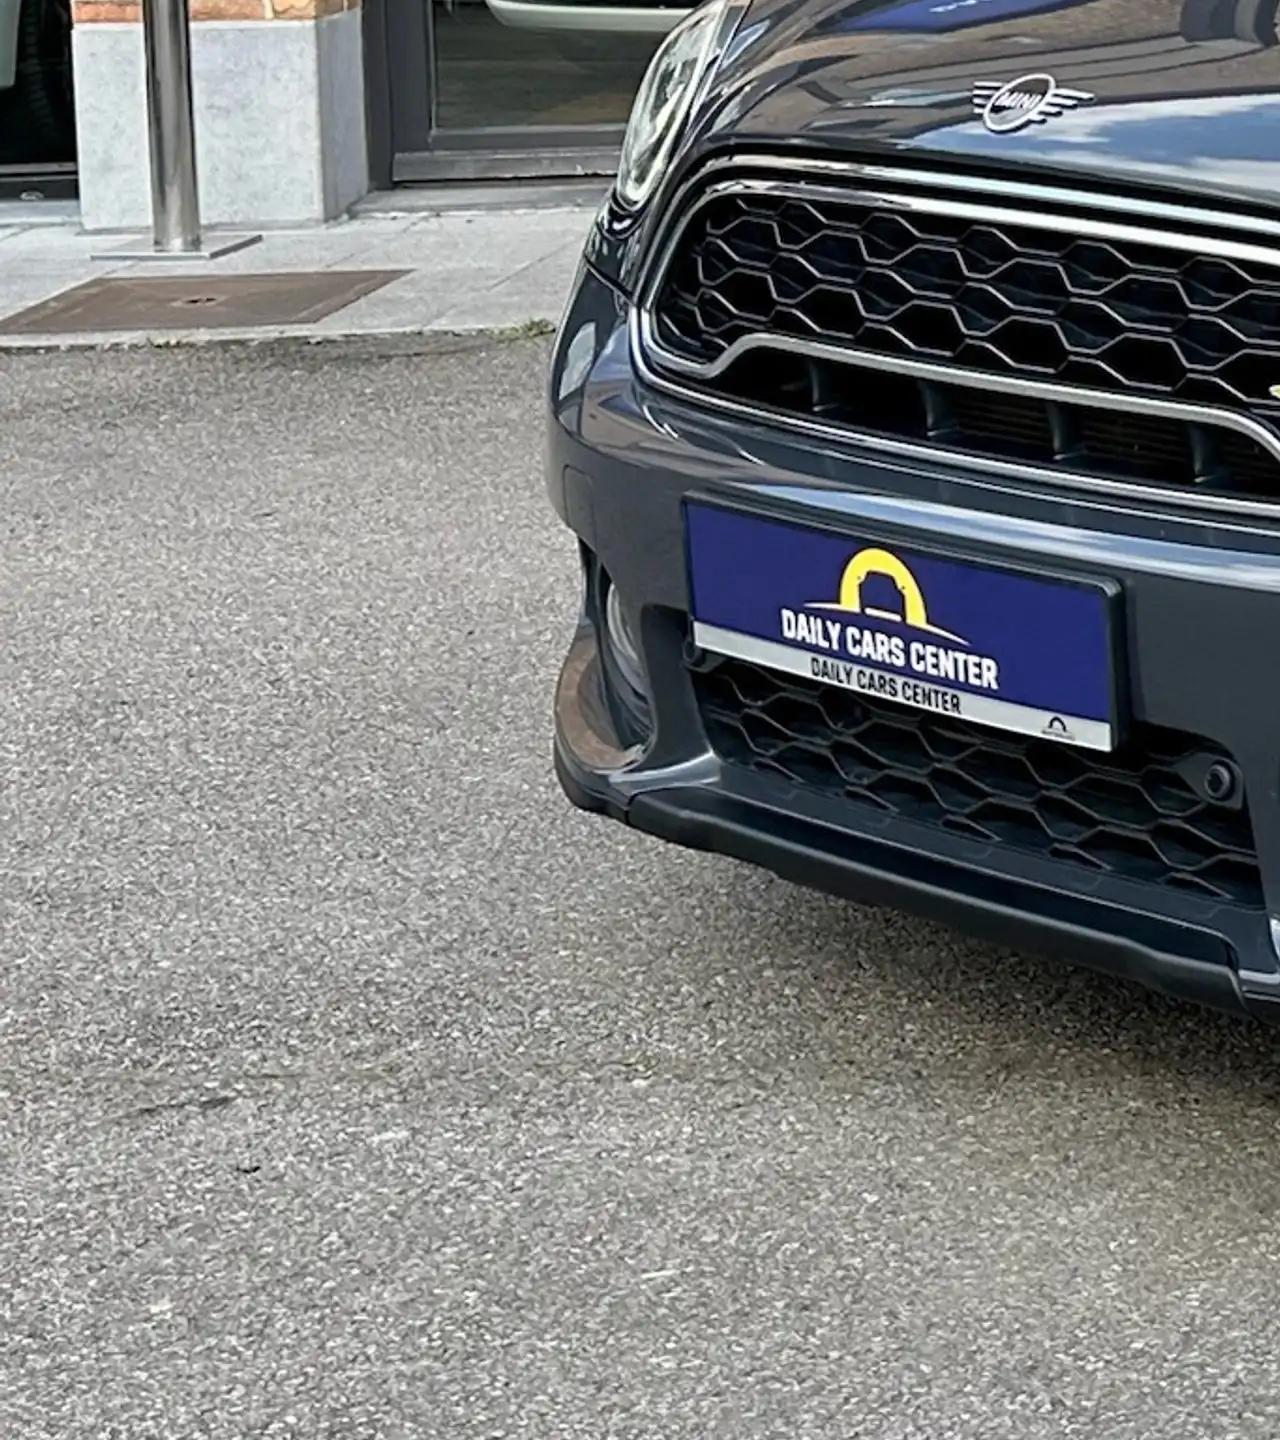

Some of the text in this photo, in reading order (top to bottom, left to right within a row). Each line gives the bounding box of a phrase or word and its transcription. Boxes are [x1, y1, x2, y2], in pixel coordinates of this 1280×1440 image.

[994, 91, 1042, 109] MINI
[781, 608, 999, 690] DAILY CARS CENTER
[810, 657, 962, 715] DAILY CARS CENTER
